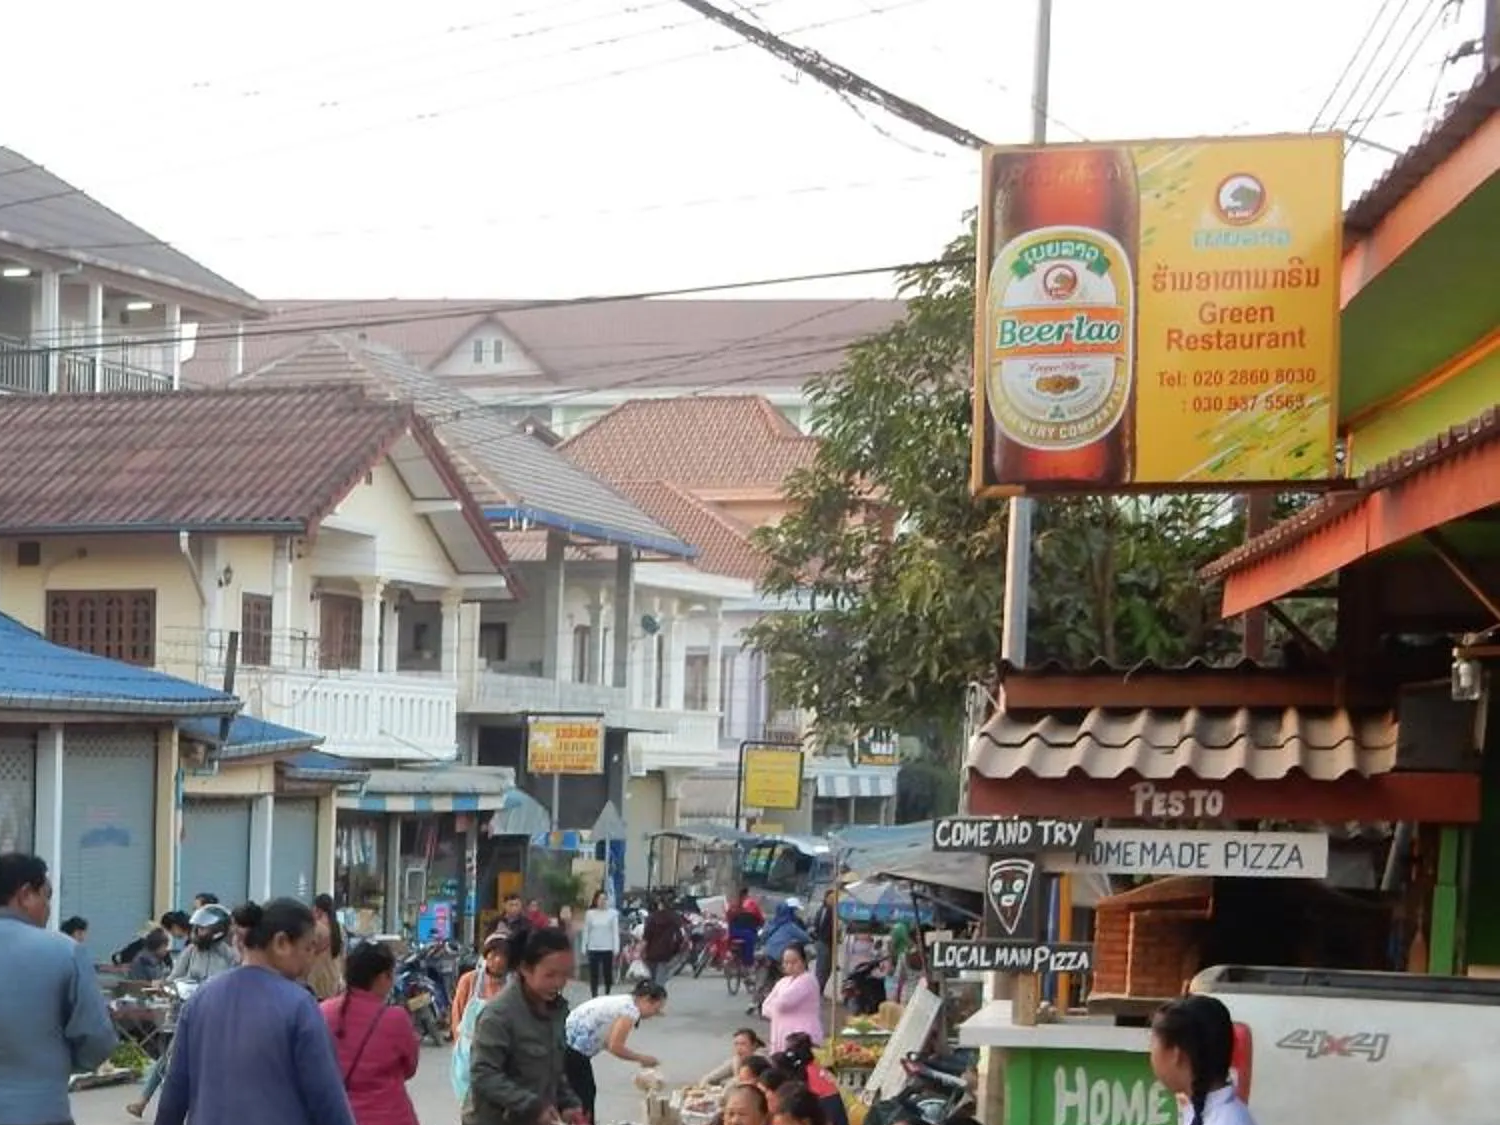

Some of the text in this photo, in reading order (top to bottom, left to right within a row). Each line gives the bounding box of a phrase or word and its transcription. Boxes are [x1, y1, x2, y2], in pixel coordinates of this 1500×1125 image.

[1198, 302, 1275, 325] Green
[998, 314, 1123, 350] Beerlao
[1166, 327, 1307, 352] Restaurant
[1156, 370, 1187, 388] Tel:
[1193, 368, 1223, 387] 020
[1130, 782, 1224, 817] PESTO
[935, 820, 1083, 847] COME AND TRY
[1224, 840, 1304, 871] PIZZA
[933, 942, 1090, 973] LOCAL MAN PIZZA
[1277, 1029, 1390, 1062] 4x4
